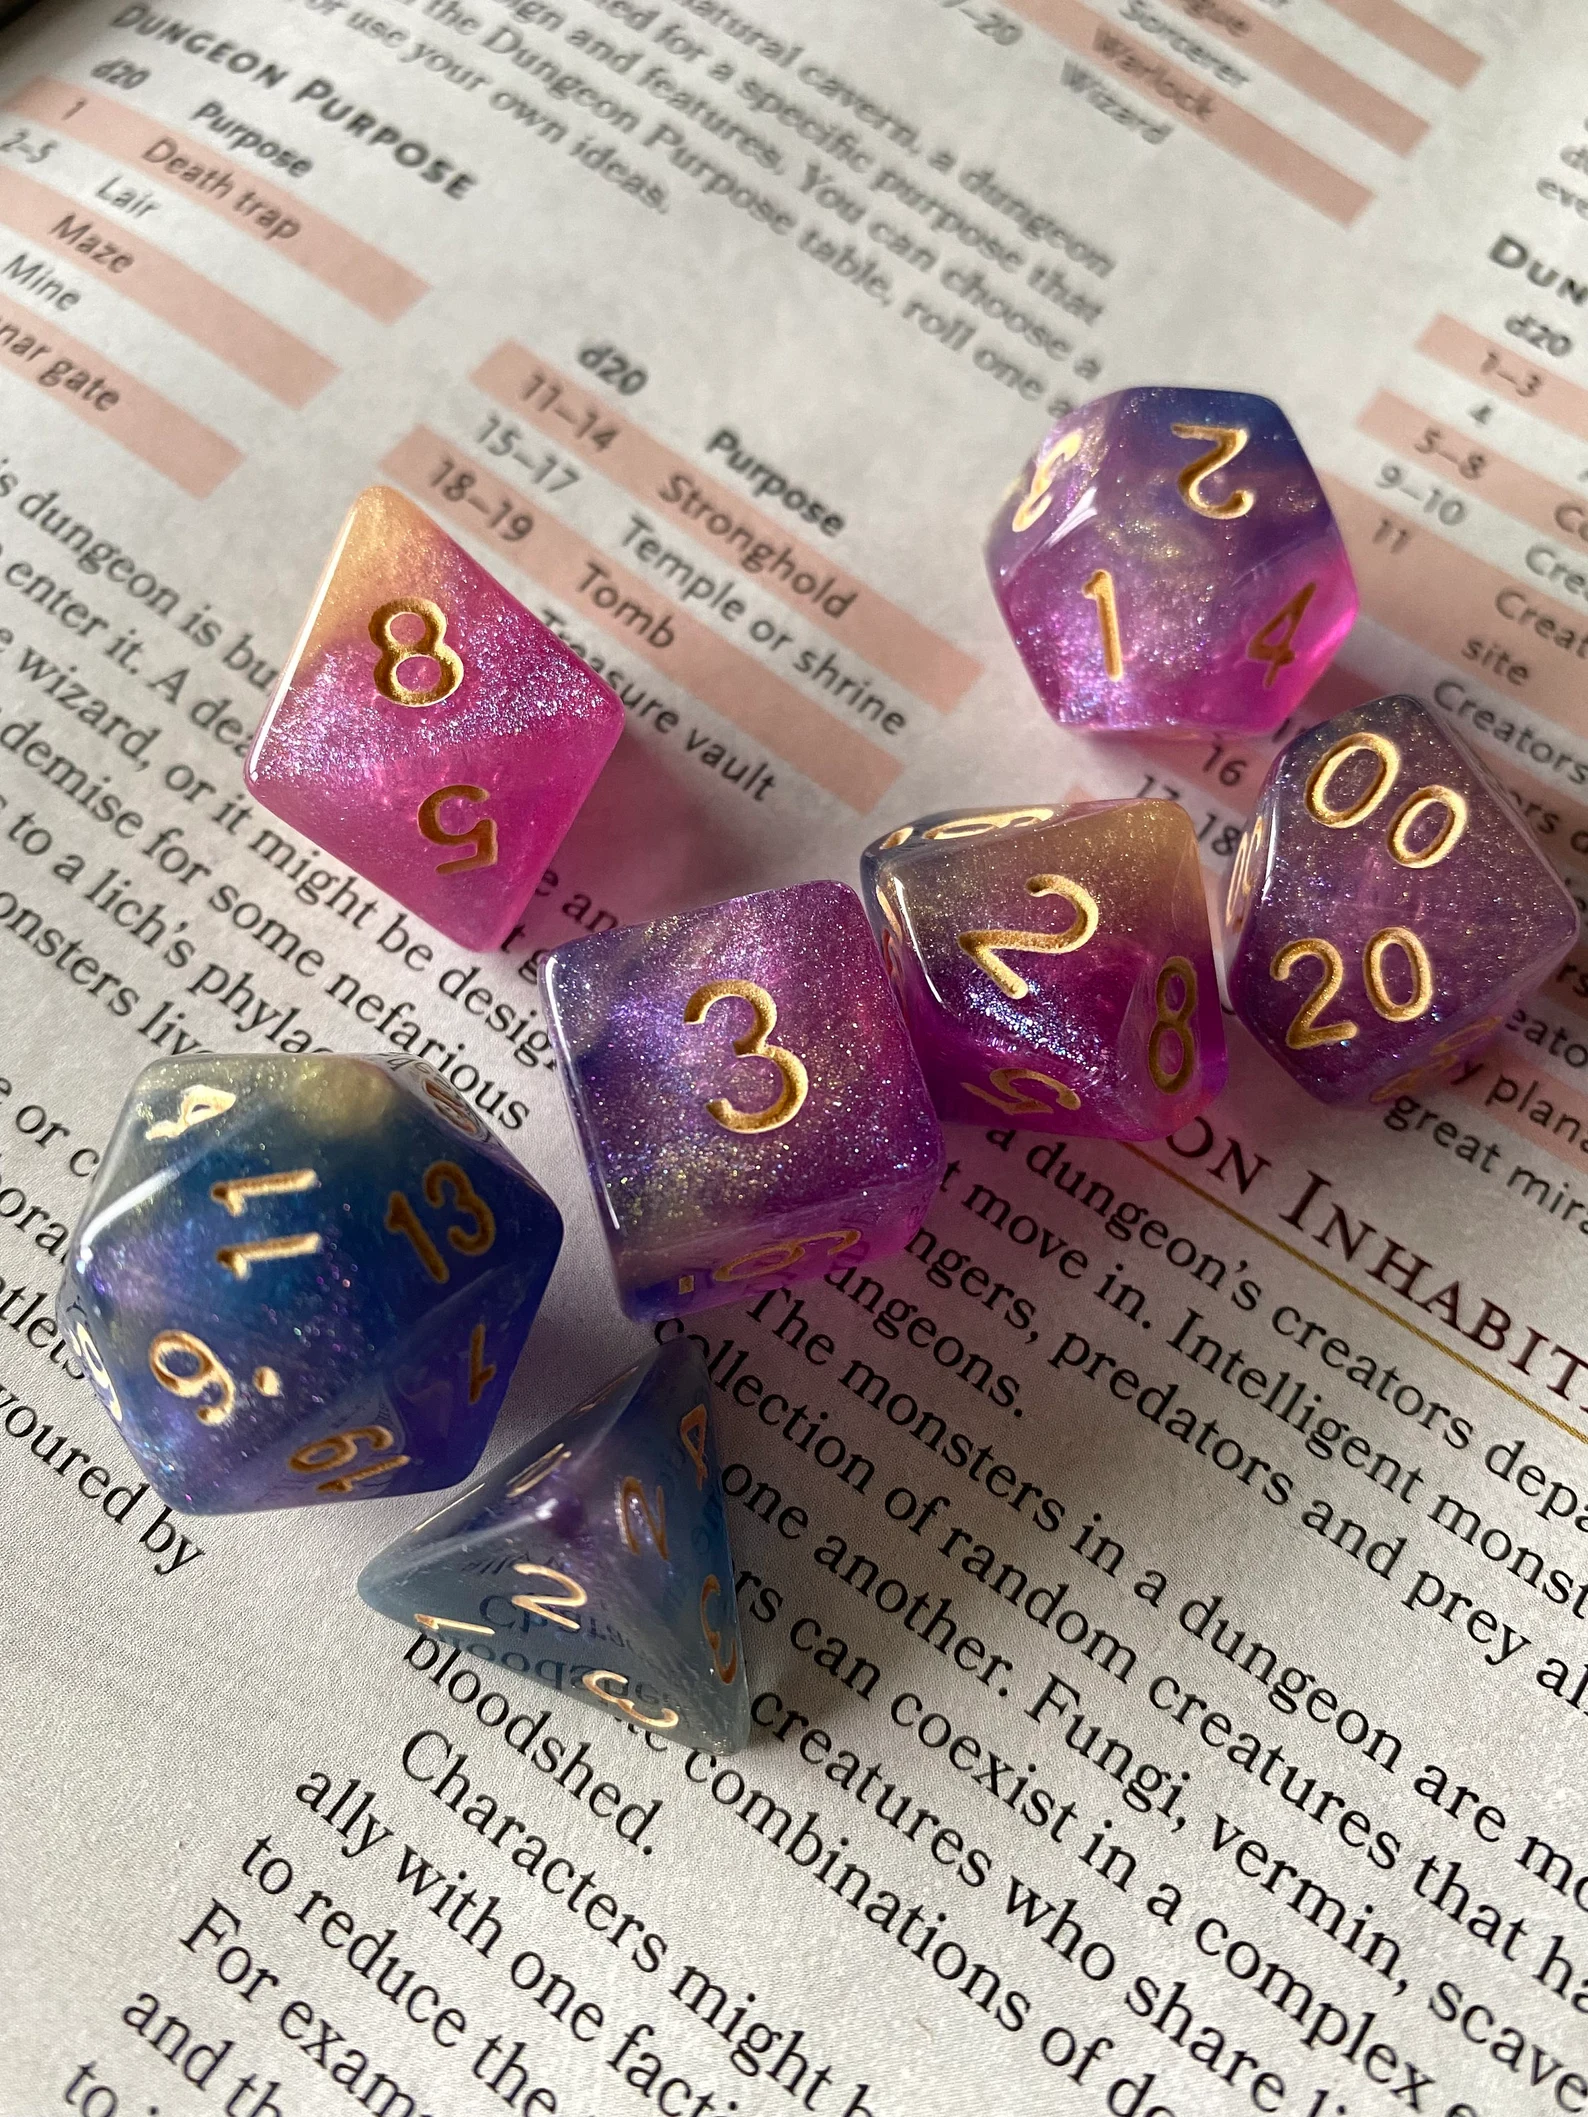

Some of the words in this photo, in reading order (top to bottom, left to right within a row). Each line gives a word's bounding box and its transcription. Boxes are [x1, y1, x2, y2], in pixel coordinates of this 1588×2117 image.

[62, 98, 87, 121] 1
[90, 55, 151, 91] d20
[112, 4, 288, 90] DUNGEON
[291, 77, 478, 201] PURPOSE
[346, 10, 409, 48] use
[397, 41, 492, 91] your
[489, 90, 569, 144] own
[570, 134, 669, 213] ideas.
[1060, 57, 1174, 145] Wizard
[142, 135, 233, 201] Death
[233, 188, 301, 242] trap
[192, 99, 315, 180] Purpose
[653, 24, 711, 62] for
[707, 61, 737, 83] a
[738, 76, 876, 173] specific
[868, 167, 1026, 273] purpose
[1027, 262, 1103, 326] that
[797, 64, 920, 156] cavern,
[927, 146, 957, 173] a
[958, 165, 1115, 279] dungeon
[48, 211, 136, 276] Maze
[95, 174, 161, 221] Lair
[480, 25, 640, 133] Dungeon
[643, 123, 797, 237] Purpose
[799, 226, 893, 307] table,
[902, 300, 976, 352] roll
[972, 347, 1045, 401] one
[564, 28, 644, 73] and
[637, 66, 786, 176] features.
[798, 158, 866, 226] You
[868, 217, 939, 273] can
[939, 257, 1072, 361] choose
[1073, 357, 1100, 382] a
[2, 252, 82, 312] Mine
[1504, 313, 1573, 357] d20
[37, 356, 121, 412] gate
[577, 340, 649, 397] d20
[1467, 402, 1494, 426] 4
[707, 427, 846, 537] Purpose
[1171, 423, 1255, 520] 2
[17, 489, 181, 618] dungeon
[178, 603, 223, 648] is
[658, 471, 859, 621] Stronghold
[1372, 518, 1410, 555] 11
[4, 560, 110, 638] enter
[103, 627, 142, 675] it.
[147, 666, 190, 706] A
[368, 597, 464, 707] 8
[576, 560, 676, 650] Tomb
[620, 515, 745, 624] Temple
[749, 616, 797, 655] or
[793, 643, 909, 738] shrine
[1081, 568, 1124, 683] 1
[1247, 582, 1316, 688] 4
[1460, 636, 1530, 686] site
[684, 721, 779, 803] vault
[1202, 745, 1249, 787] 16
[1434, 680, 1588, 786] Creators
[417, 784, 498, 875] 5
[1197, 812, 1242, 857] 18
[1304, 731, 1469, 869] 00
[8, 811, 53, 856] to
[52, 853, 86, 885] a
[84, 866, 196, 968] lich's
[18, 646, 162, 772] wizard,
[164, 763, 217, 803] or
[212, 790, 255, 836] it
[249, 827, 379, 930] might
[376, 912, 434, 973] be
[438, 966, 557, 1073] desig
[1, 720, 144, 839] demise
[143, 827, 211, 886] for
[208, 885, 325, 978] some
[324, 972, 530, 1130] nefarious
[957, 873, 1100, 1000] 2
[1148, 956, 1197, 1094] 8
[1270, 927, 1433, 1050] 20
[684, 979, 808, 1134] 3
[961, 1068, 1082, 1115] 5
[15, 1105, 70, 1149] or
[1383, 1095, 1502, 1174] great
[384, 1160, 497, 1284] 13
[963, 1183, 1090, 1281] move
[1094, 1262, 1153, 1330] in.
[1167, 1308, 1425, 1505] Intelligent
[1025, 1141, 1262, 1312] dungeon’s
[1272, 1306, 1475, 1450] creators
[1279, 1170, 1588, 1412] INHABIT
[138, 1504, 206, 1576] by
[1048, 1331, 1296, 1506] predators
[1301, 1499, 1406, 1580] and
[1403, 1569, 1531, 1666] prey
[512, 1562, 588, 1632] 2
[746, 1286, 835, 1366] The
[839, 1359, 1066, 1533] monsters
[1071, 1513, 1130, 1579] in
[1133, 1569, 1168, 1607] a
[1179, 1596, 1403, 1774] dungeon
[1414, 1764, 1506, 1843] are
[403, 1632, 664, 1856] bloodshed.
[582, 1669, 679, 1729] 3
[722, 1462, 808, 1541] one
[813, 1534, 1014, 1698] another.
[1025, 1672, 1187, 1833] Fungi,
[1211, 1813, 1410, 1998] vermin,
[884, 1485, 950, 1536] of
[939, 1527, 1138, 1684] random
[1148, 1674, 1402, 1871] creatures
[1412, 1854, 1528, 1961] that
[296, 1772, 394, 1860] ally
[397, 1844, 502, 1959] with
[510, 1950, 604, 2042] one
[402, 1729, 668, 1973] Characters
[669, 1964, 833, 2112] might
[685, 1747, 1032, 2032] combinations
[1040, 2026, 1114, 2085] of
[751, 1691, 994, 1888] creatures
[1004, 1876, 1116, 1982] who
[1124, 1975, 1286, 2113] share
[790, 1616, 882, 1702] can
[890, 1690, 1079, 1843] coexist
[1078, 1819, 1137, 1892] in
[1146, 1882, 1181, 1927] a
[1195, 1918, 1435, 2113] complex
[180, 1898, 279, 2002] For
[241, 1834, 293, 1895] to
[294, 1890, 467, 2048] reduce
[63, 2060, 118, 2117] to
[122, 1992, 235, 2092] and
